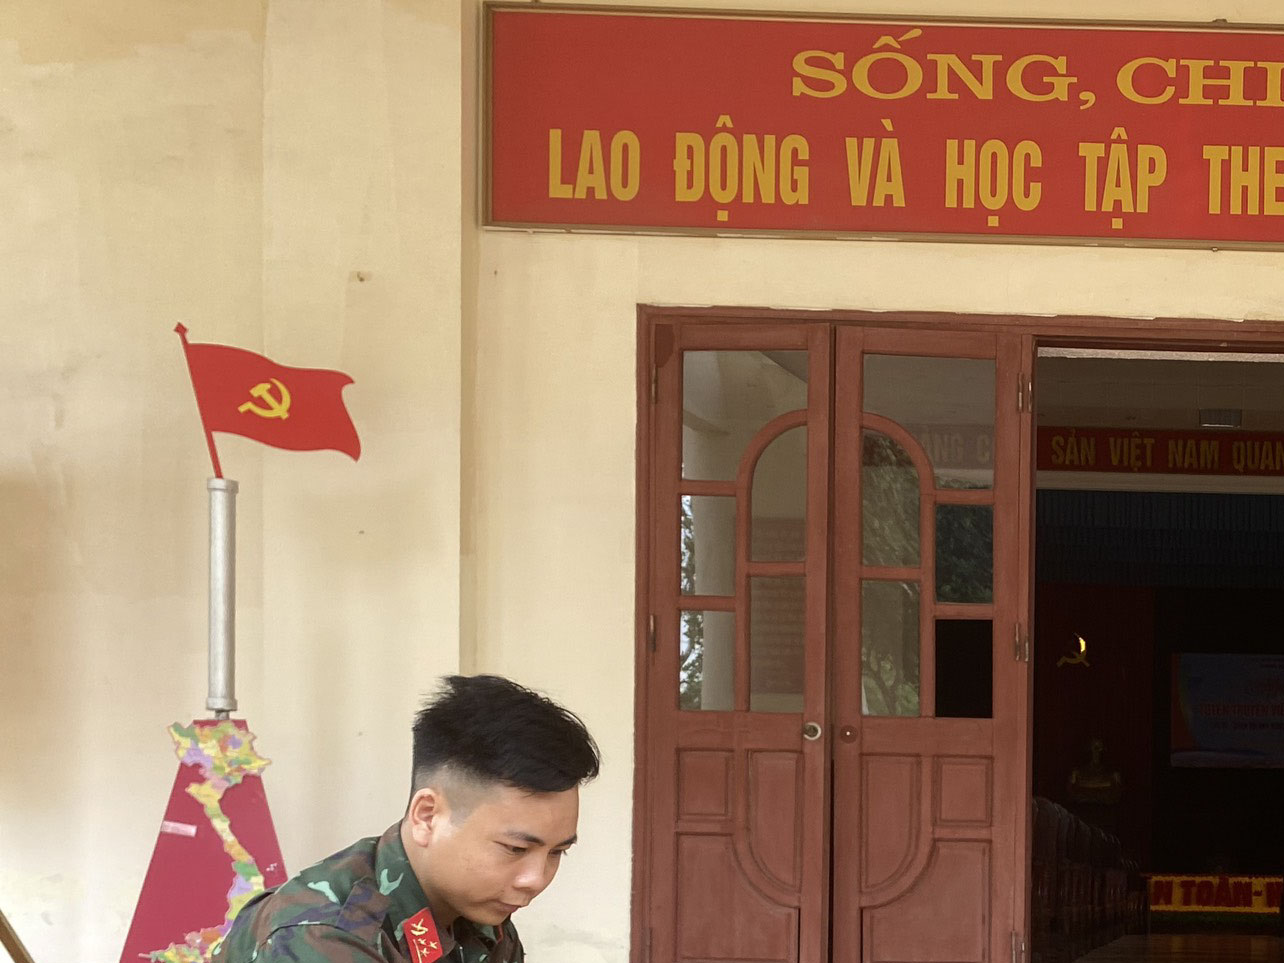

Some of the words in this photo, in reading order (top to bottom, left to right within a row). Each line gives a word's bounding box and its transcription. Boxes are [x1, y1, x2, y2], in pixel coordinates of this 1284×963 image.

[792, 28, 1096, 110] SỐNG,
[548, 128, 641, 202] LAO
[673, 114, 810, 222] ĐỘNG
[845, 118, 906, 208] VÀ
[944, 138, 1043, 227] HỌC
[1078, 127, 1168, 230] TẬP
[1050, 428, 1096, 466] SẢN
[1108, 431, 1156, 472] VIỆT
[1167, 439, 1220, 469] NAM
